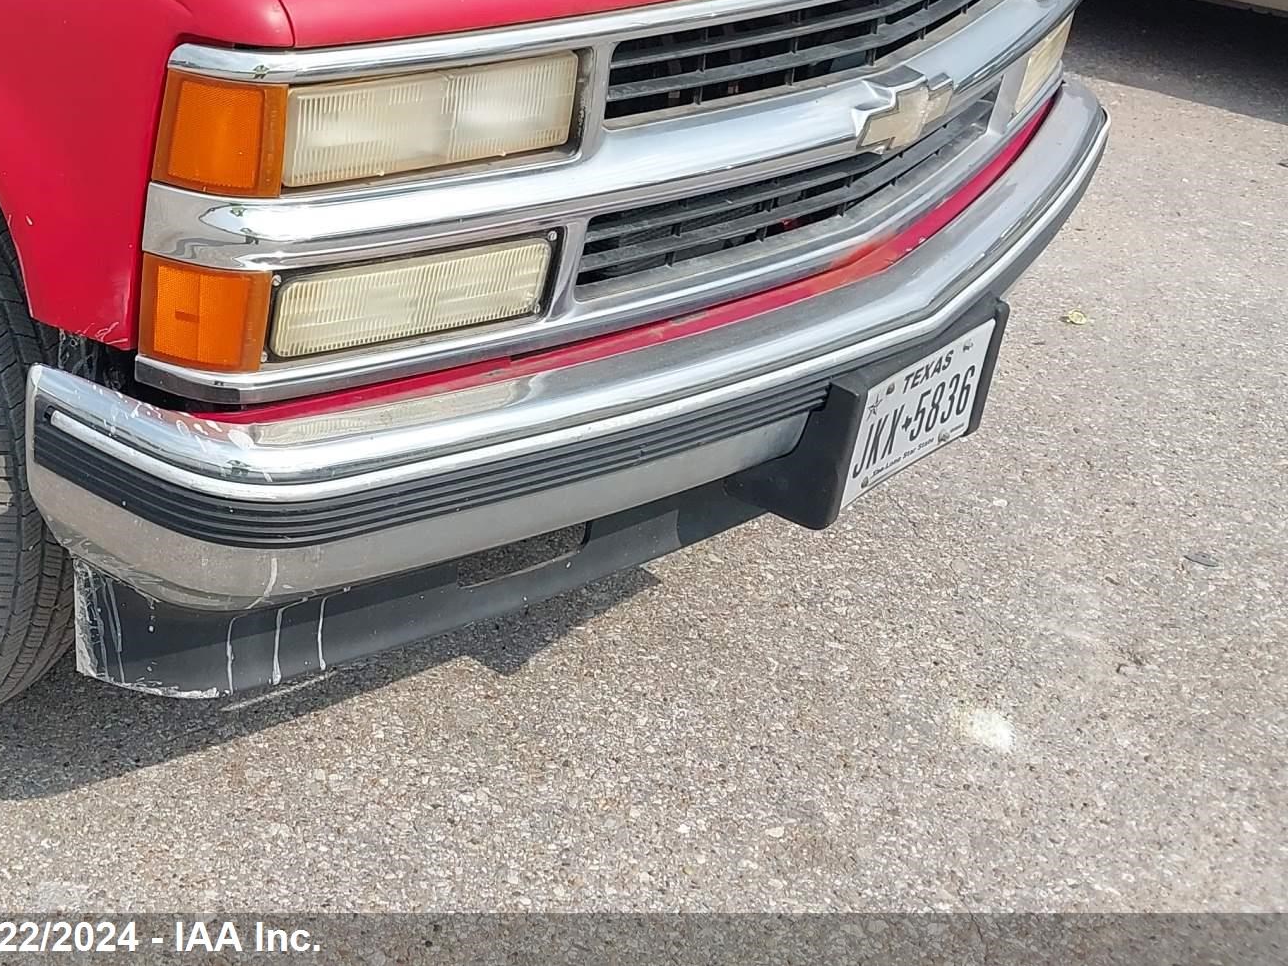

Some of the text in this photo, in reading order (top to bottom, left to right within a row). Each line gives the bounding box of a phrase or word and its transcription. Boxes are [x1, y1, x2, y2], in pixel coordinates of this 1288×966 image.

[902, 349, 954, 394] TEXAS
[903, 447, 917, 459] Star
[917, 437, 934, 451] State
